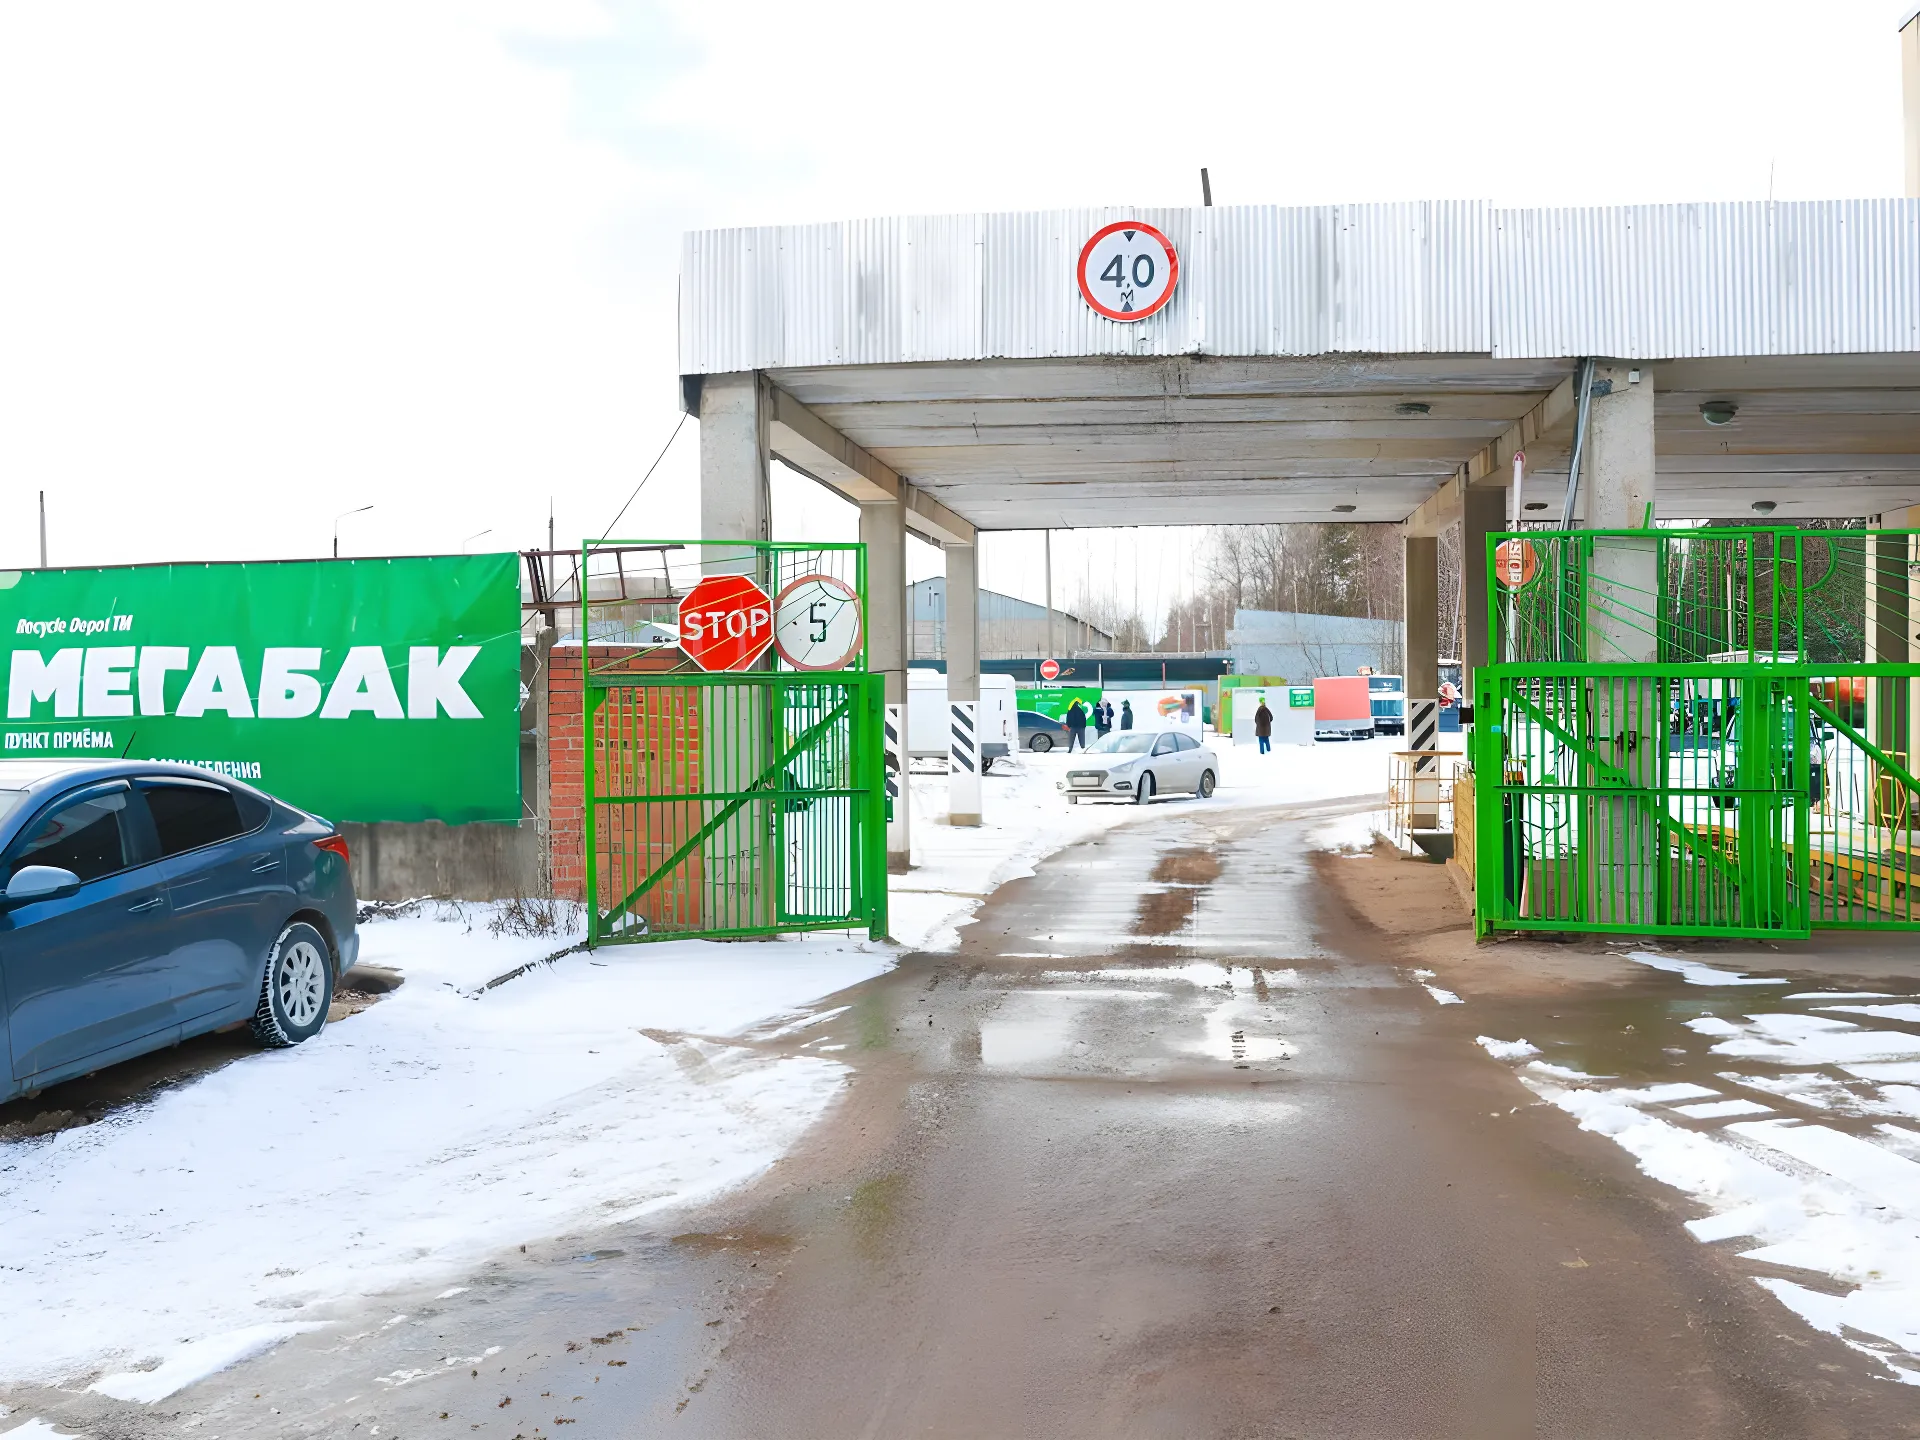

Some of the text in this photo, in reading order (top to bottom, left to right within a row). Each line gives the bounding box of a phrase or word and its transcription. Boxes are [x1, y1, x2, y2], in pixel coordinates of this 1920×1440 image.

[683, 608, 769, 641] STOP
[809, 602, 827, 643] 5
[7, 645, 485, 720] МЕГАБАК
[4, 727, 114, 749] ПУНКТ ПРИЁМА
